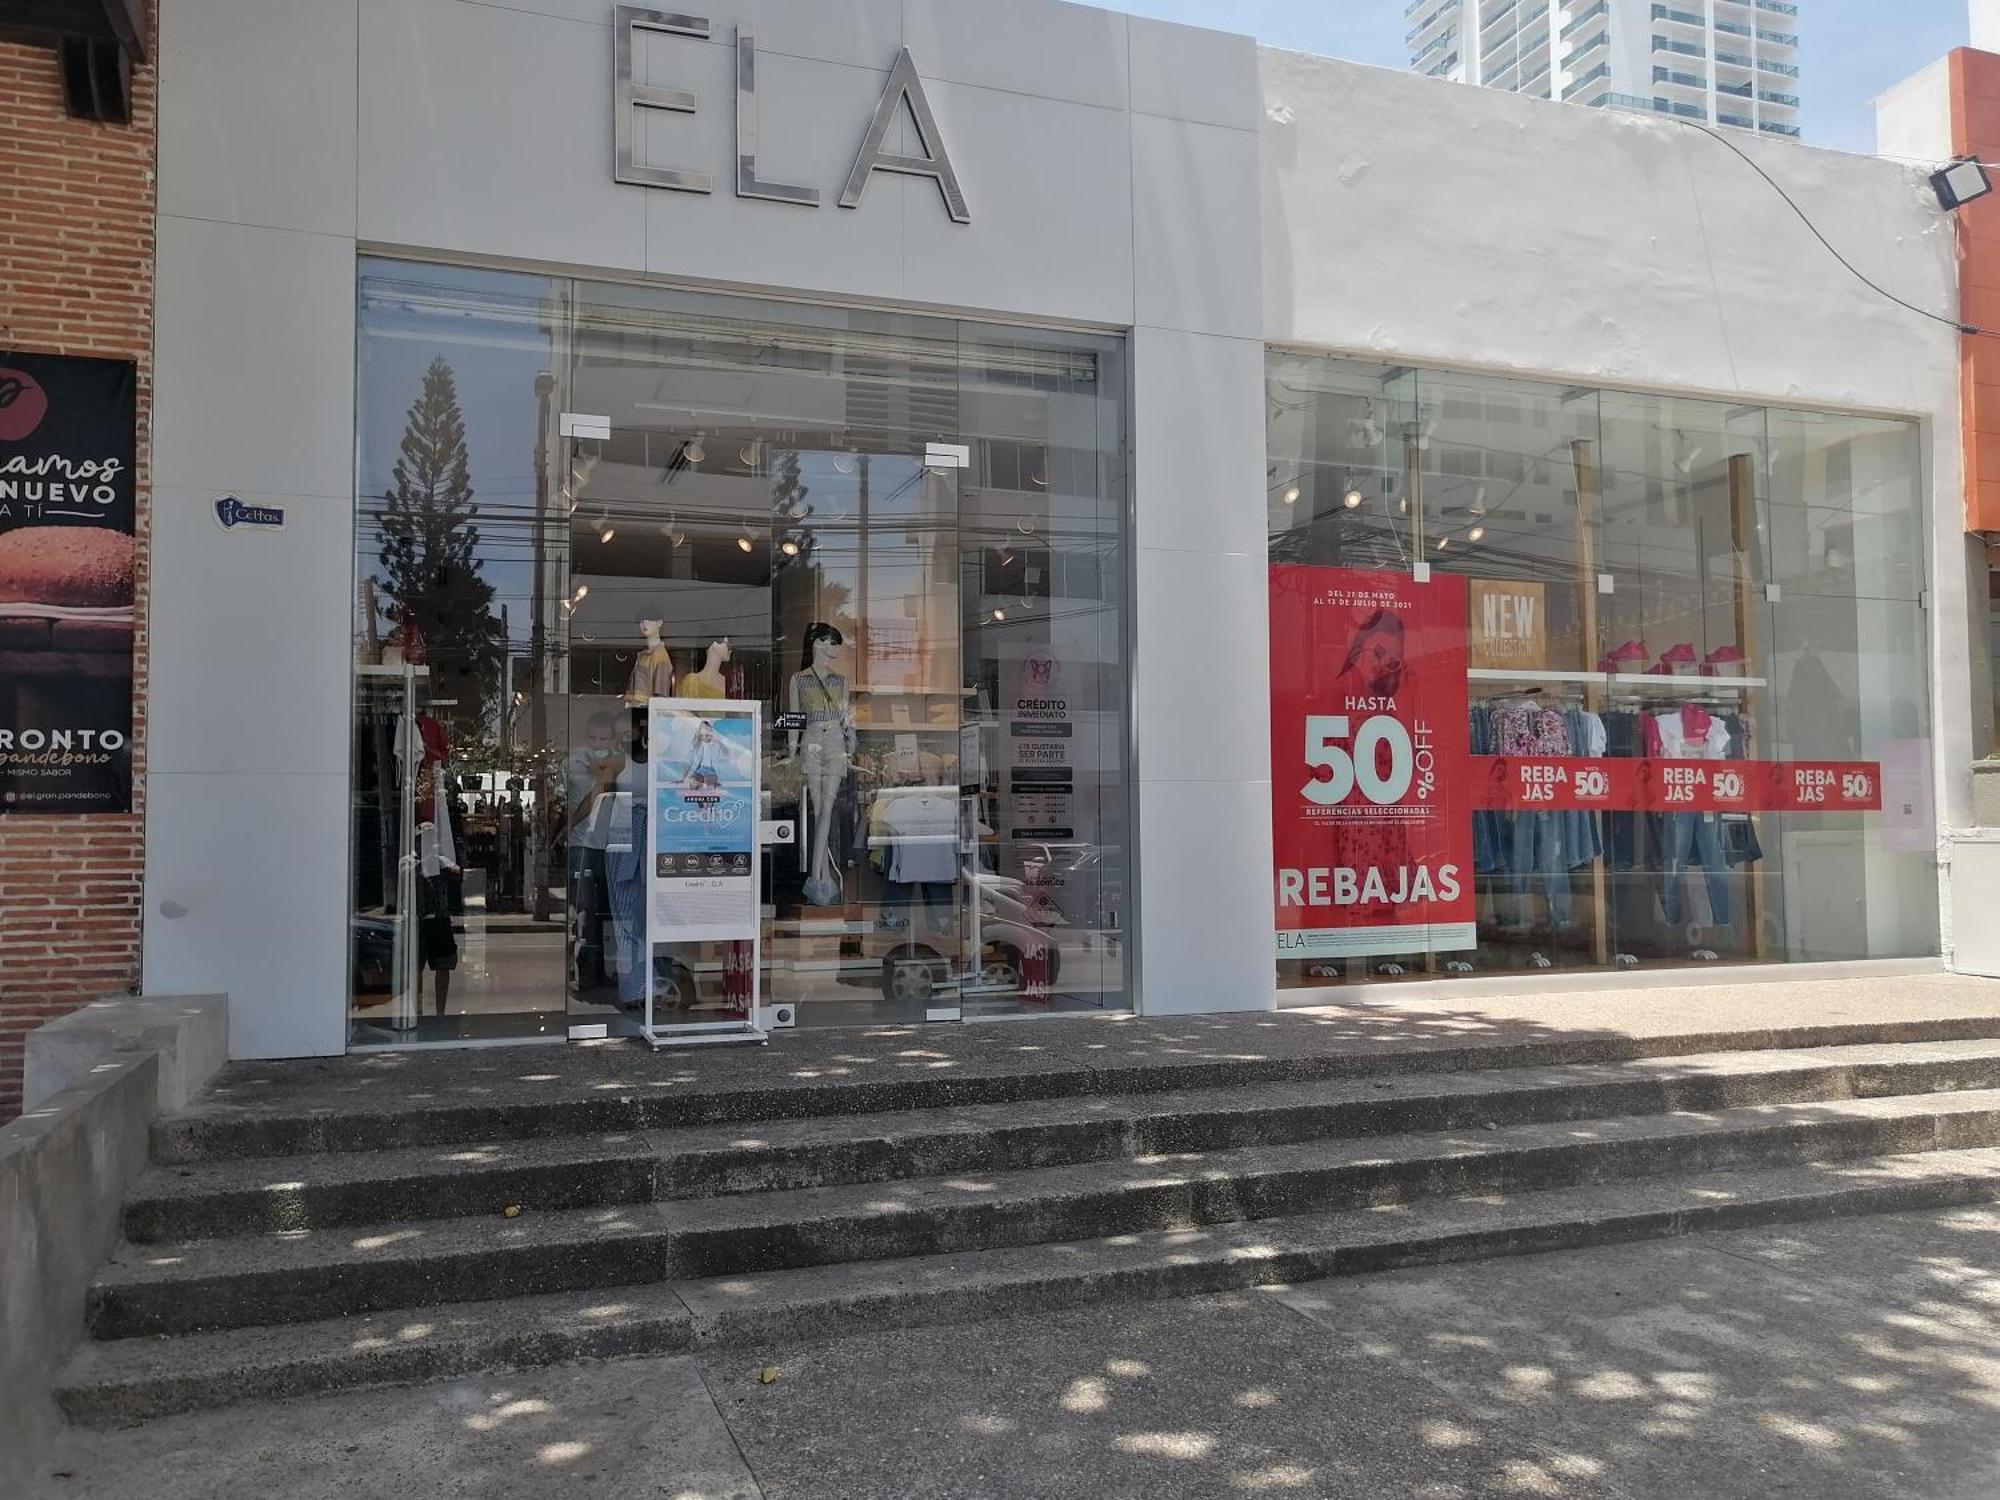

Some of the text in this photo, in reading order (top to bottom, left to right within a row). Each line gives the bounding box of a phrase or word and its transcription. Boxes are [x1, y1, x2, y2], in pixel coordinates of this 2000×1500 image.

[614, 4, 970, 224] ELA
[0, 454, 125, 482] amos
[0, 480, 116, 504] NUEVO
[1352, 600, 1377, 608] JULIO
[1380, 600, 1391, 608] DE
[1393, 601, 1412, 609] 2021
[1371, 592, 1396, 600] MAYO
[1483, 594, 1536, 638] NEW
[1017, 698, 1066, 710] CRÉDITO
[1345, 696, 1397, 711] HASTA
[1300, 715, 1413, 805] 50
[1520, 766, 1568, 783] REBA
[1574, 771, 1604, 796] 50
[1663, 767, 1706, 785] REBA
[1712, 773, 1740, 797] 50
[1795, 769, 1836, 786] REBA
[1842, 774, 1868, 798] 50
[1521, 783, 1555, 801] JAS
[1664, 785, 1695, 802] JAS
[1796, 786, 1825, 803] JAS
[1306, 807, 1361, 816] REFERENCIAS
[1279, 864, 1461, 907] REBAJAS
[1278, 932, 1306, 949] ELA
